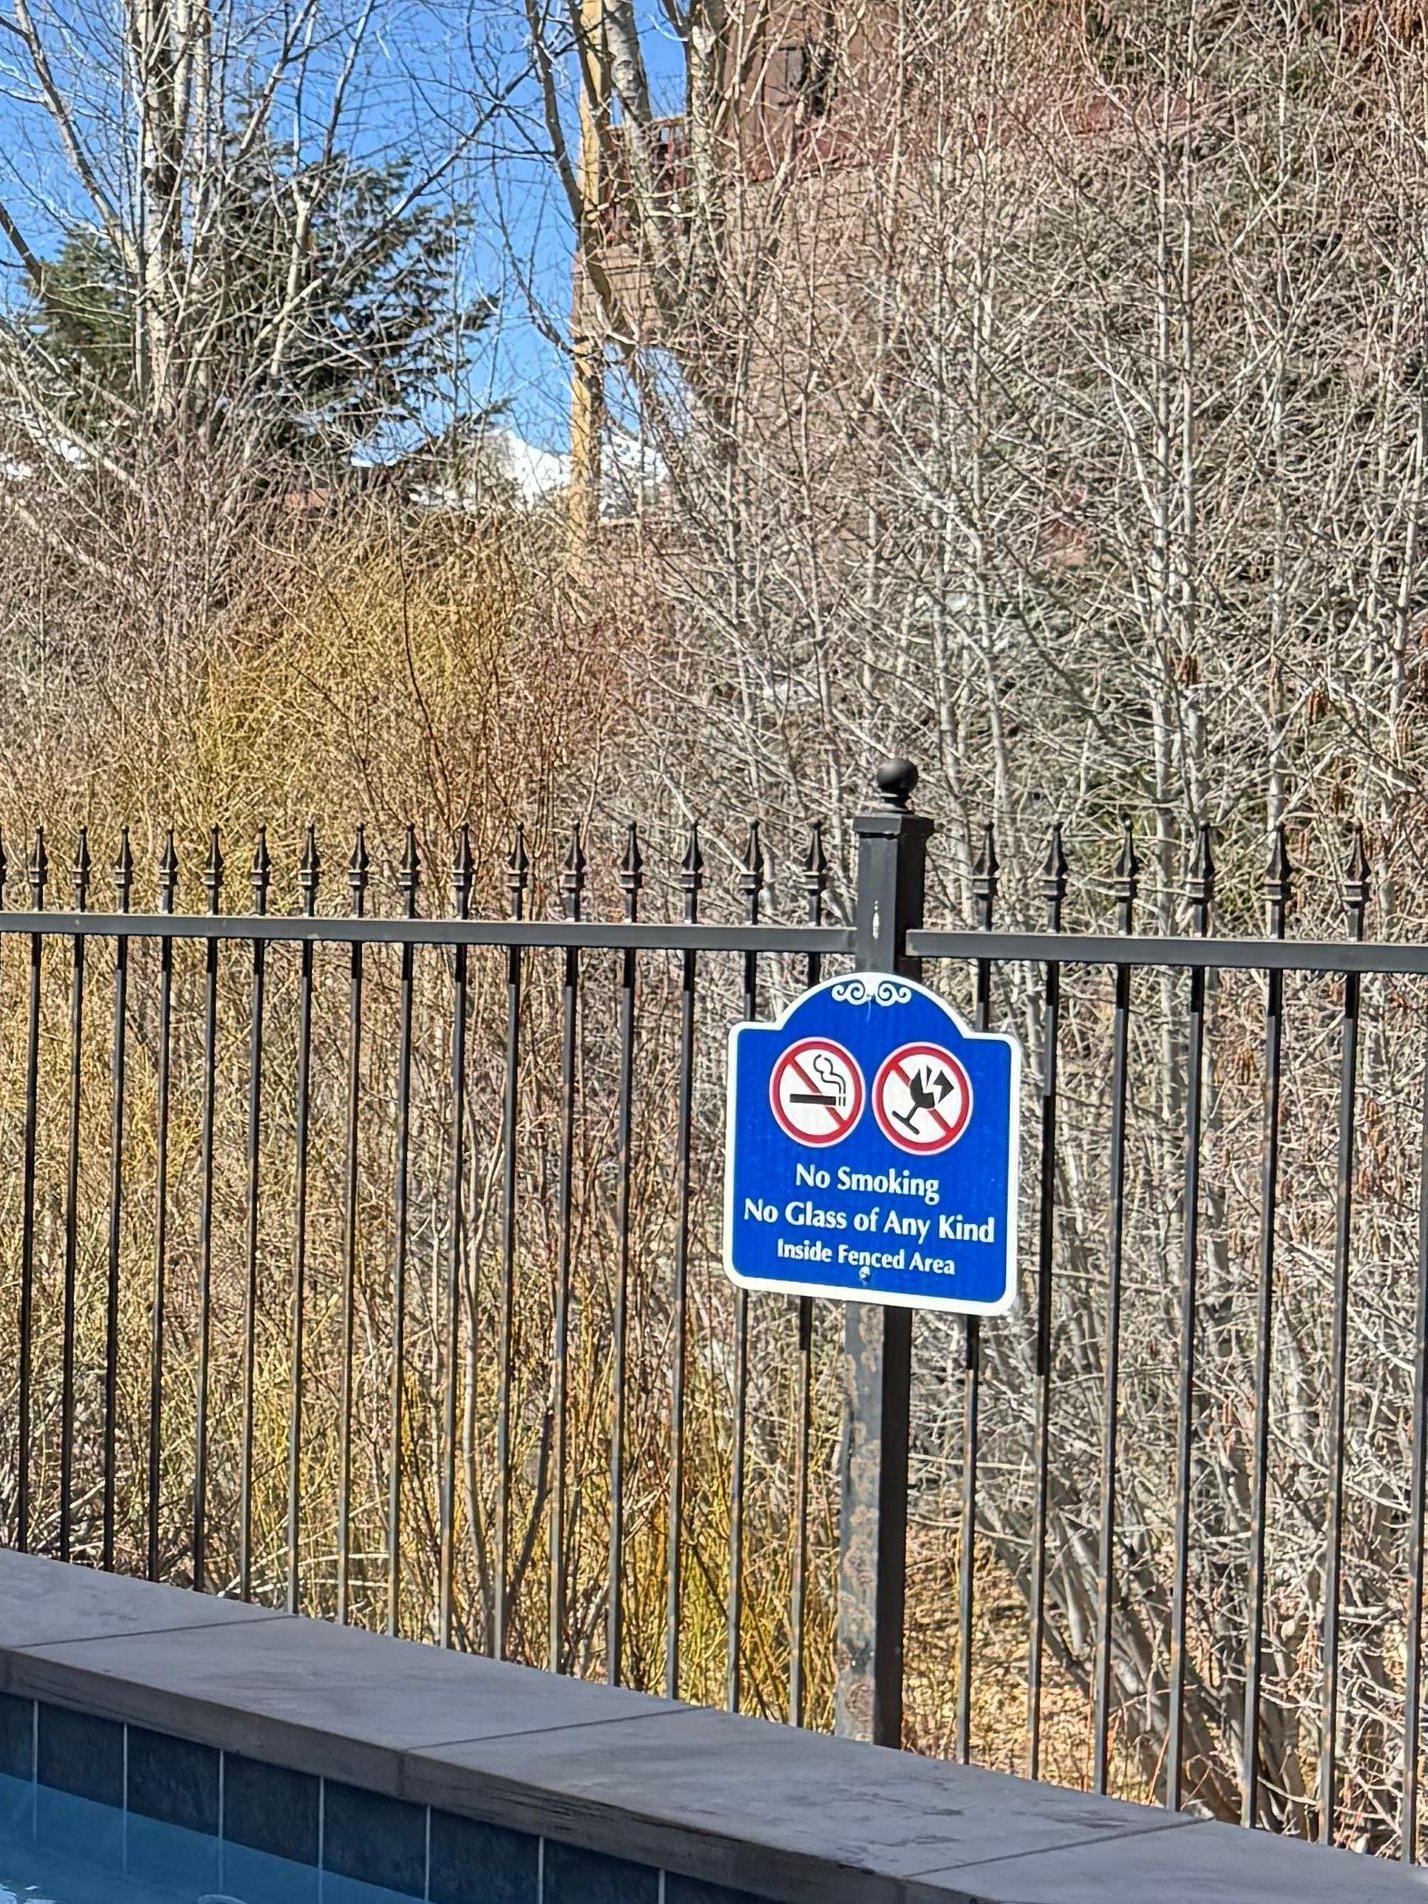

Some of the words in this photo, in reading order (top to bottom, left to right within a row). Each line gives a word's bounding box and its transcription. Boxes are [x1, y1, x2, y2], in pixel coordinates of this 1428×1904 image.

[795, 1162, 831, 1190] No
[837, 1166, 940, 1205] Smoking
[743, 1198, 779, 1223] No
[785, 1201, 848, 1231] Glass
[853, 1207, 879, 1233] of
[884, 1211, 931, 1245] Any
[938, 1214, 996, 1244] Kind
[776, 1238, 833, 1263] Inside
[837, 1244, 906, 1271] Fenced
[909, 1254, 956, 1276] Area
